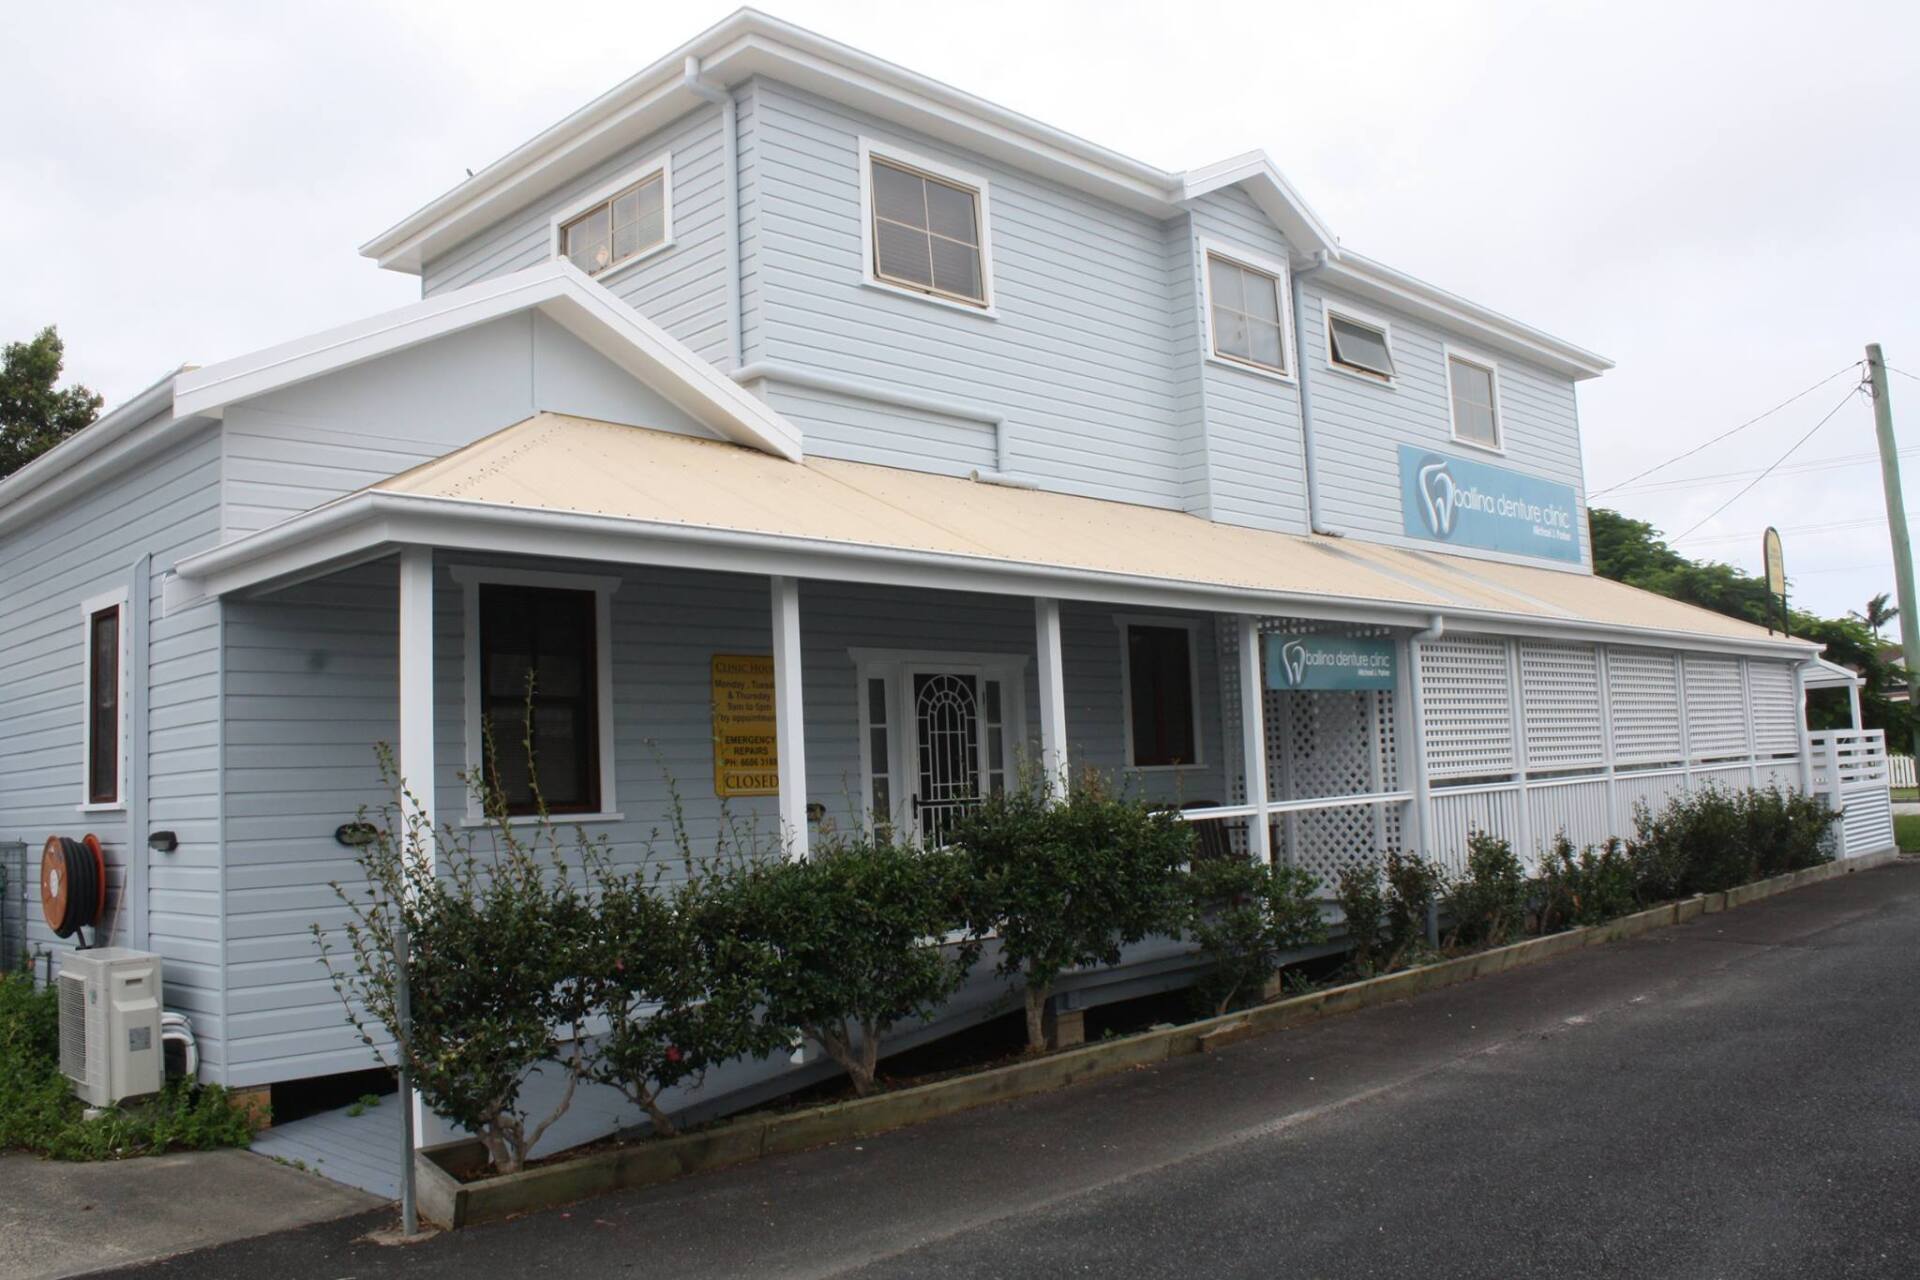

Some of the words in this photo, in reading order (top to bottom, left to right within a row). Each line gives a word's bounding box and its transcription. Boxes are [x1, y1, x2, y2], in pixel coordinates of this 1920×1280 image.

[1453, 484, 1494, 514] ballina
[1497, 492, 1541, 522] denture
[1543, 504, 1570, 528] clinic
[1305, 649, 1334, 666] ballina
[1336, 650, 1369, 667] denture
[1370, 651, 1390, 667] clinic
[750, 663, 774, 674] HOU
[714, 679, 745, 691] Monday
[735, 690, 770, 702] Thursday
[745, 702, 753, 711] to
[720, 714, 730, 724] by
[725, 735, 776, 745] EMERGENCY
[734, 746, 769, 755] REPAIRS
[725, 774, 779, 789] CLOSED
